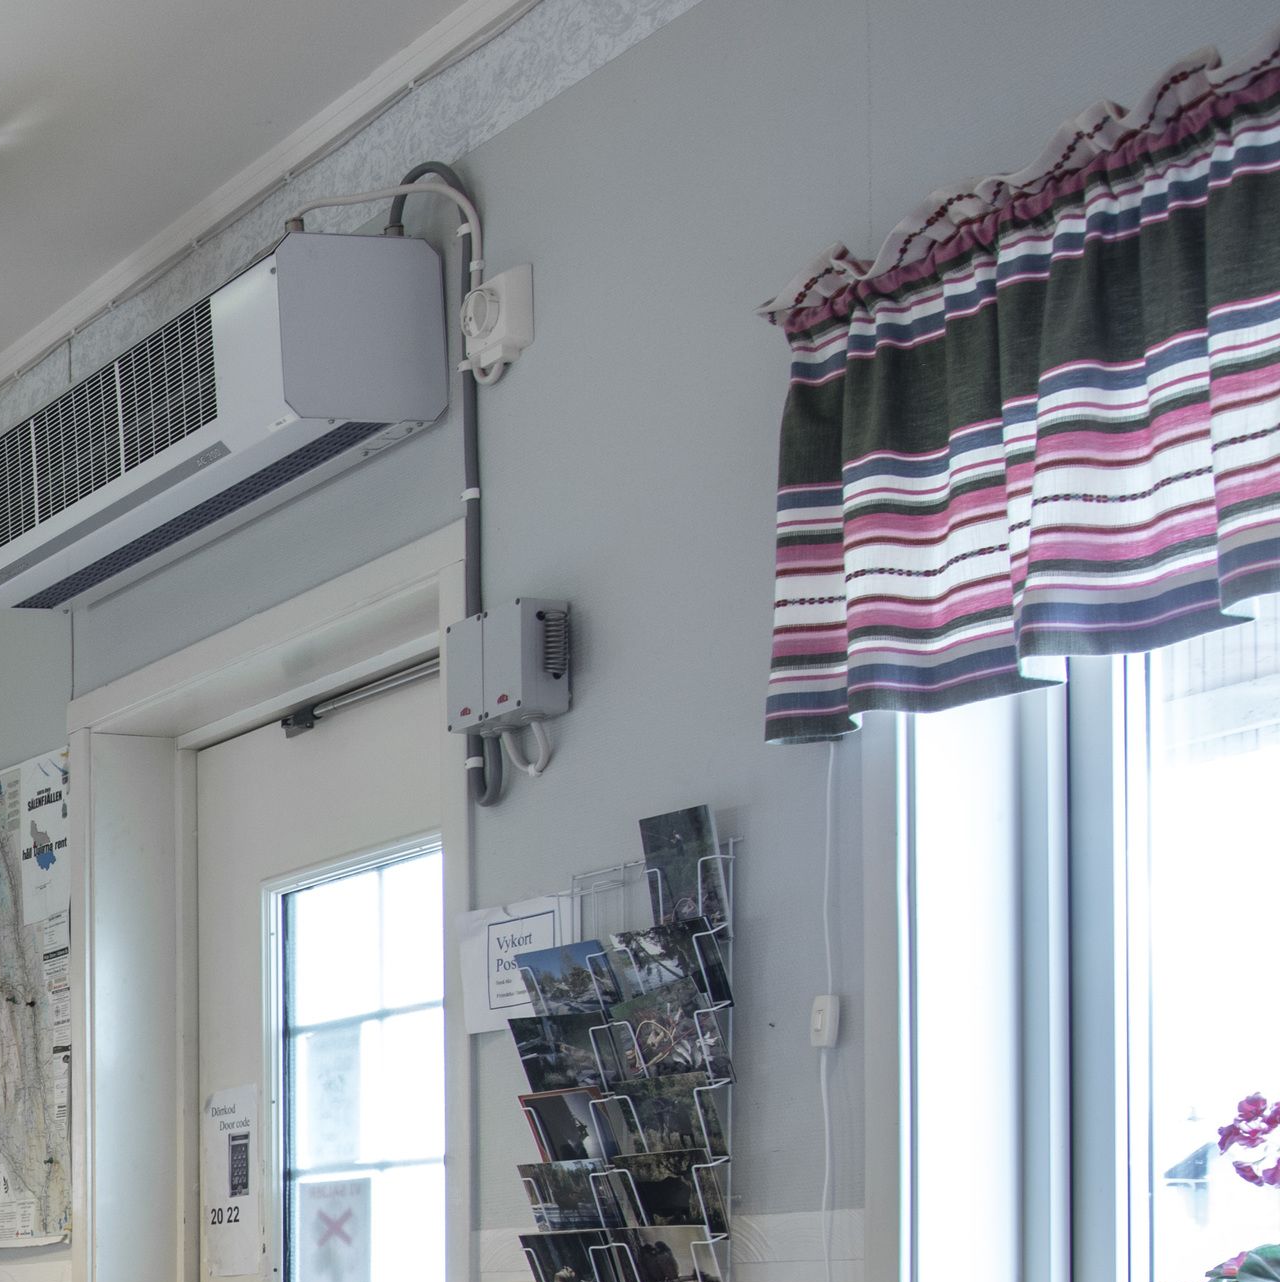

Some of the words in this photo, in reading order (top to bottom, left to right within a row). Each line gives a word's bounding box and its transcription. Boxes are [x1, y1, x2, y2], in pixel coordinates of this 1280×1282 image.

[55, 837, 67, 850] rent
[496, 932, 532, 953] Vykort
[220, 1120, 236, 1131] Door
[236, 1117, 250, 1128] code
[211, 1208, 223, 1225] 20
[227, 1206, 240, 1223] 22
